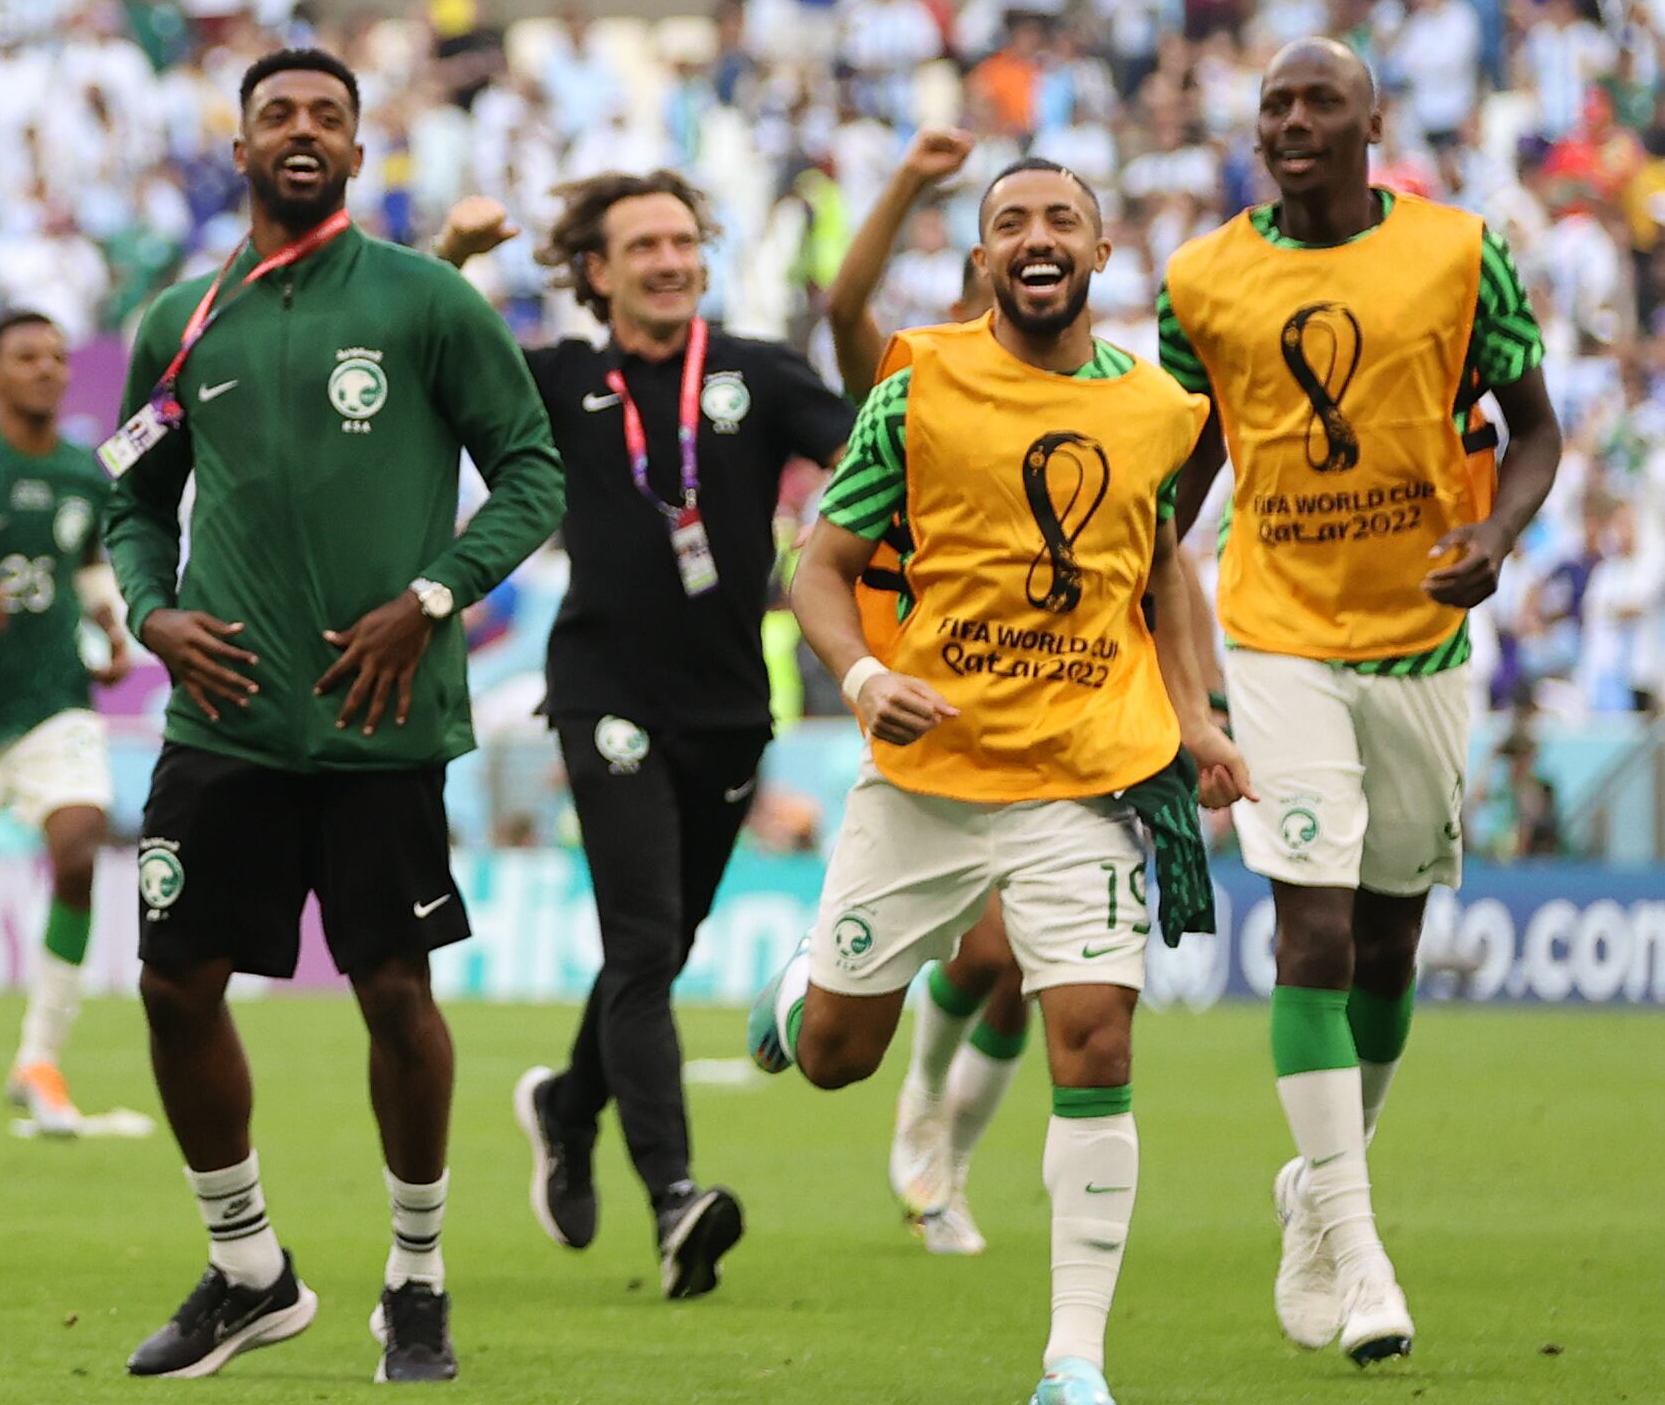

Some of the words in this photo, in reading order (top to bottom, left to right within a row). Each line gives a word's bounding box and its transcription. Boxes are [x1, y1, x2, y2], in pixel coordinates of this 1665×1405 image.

[1296, 488, 1385, 515] WORLD
[1390, 480, 1437, 501] CUP
[998, 625, 1088, 655] WORLD
